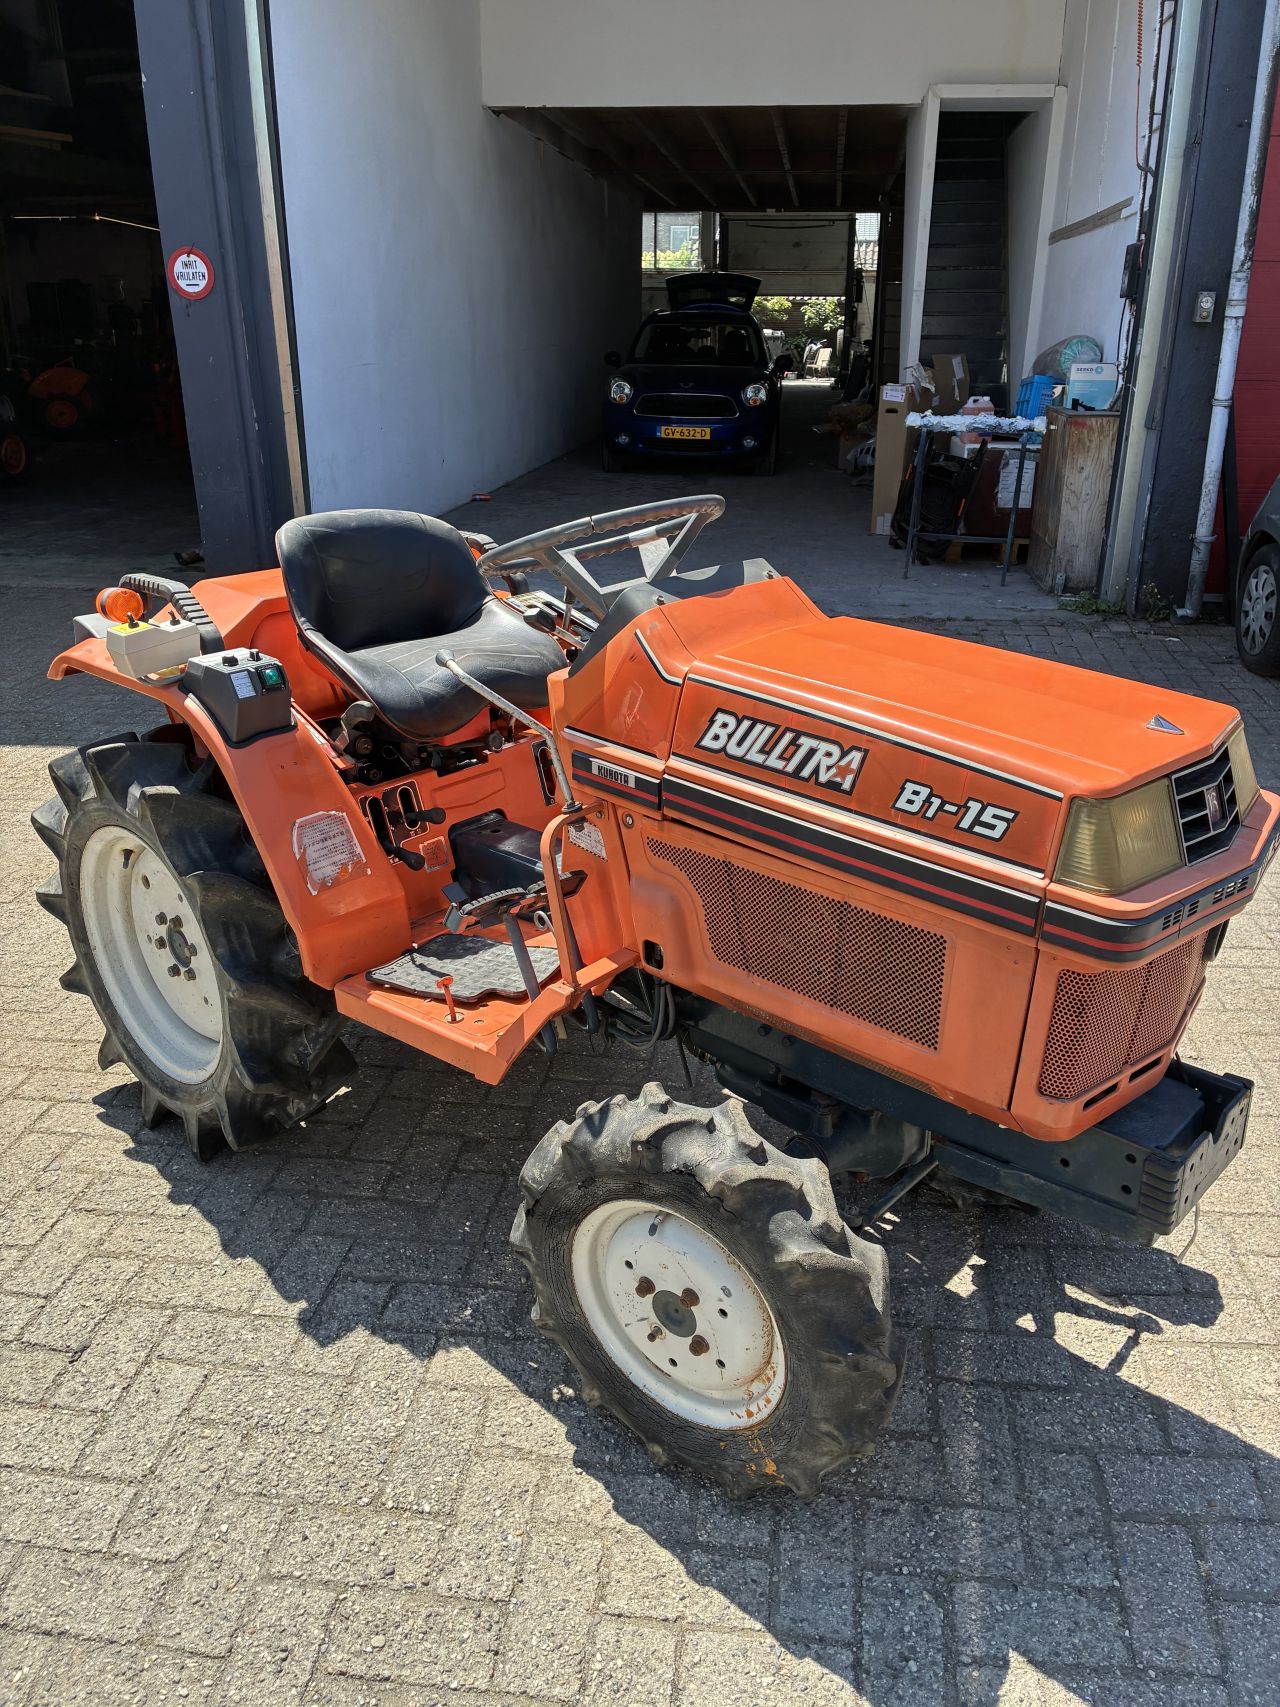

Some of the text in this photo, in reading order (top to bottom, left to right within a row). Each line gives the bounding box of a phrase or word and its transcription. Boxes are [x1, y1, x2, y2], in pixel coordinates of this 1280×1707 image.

[181, 260, 198, 270] INRIT
[664, 428, 707, 438] GV-632-D
[697, 709, 866, 793] BULLTRA
[597, 764, 629, 786] KUBOTA
[893, 780, 1018, 840] B1-15
